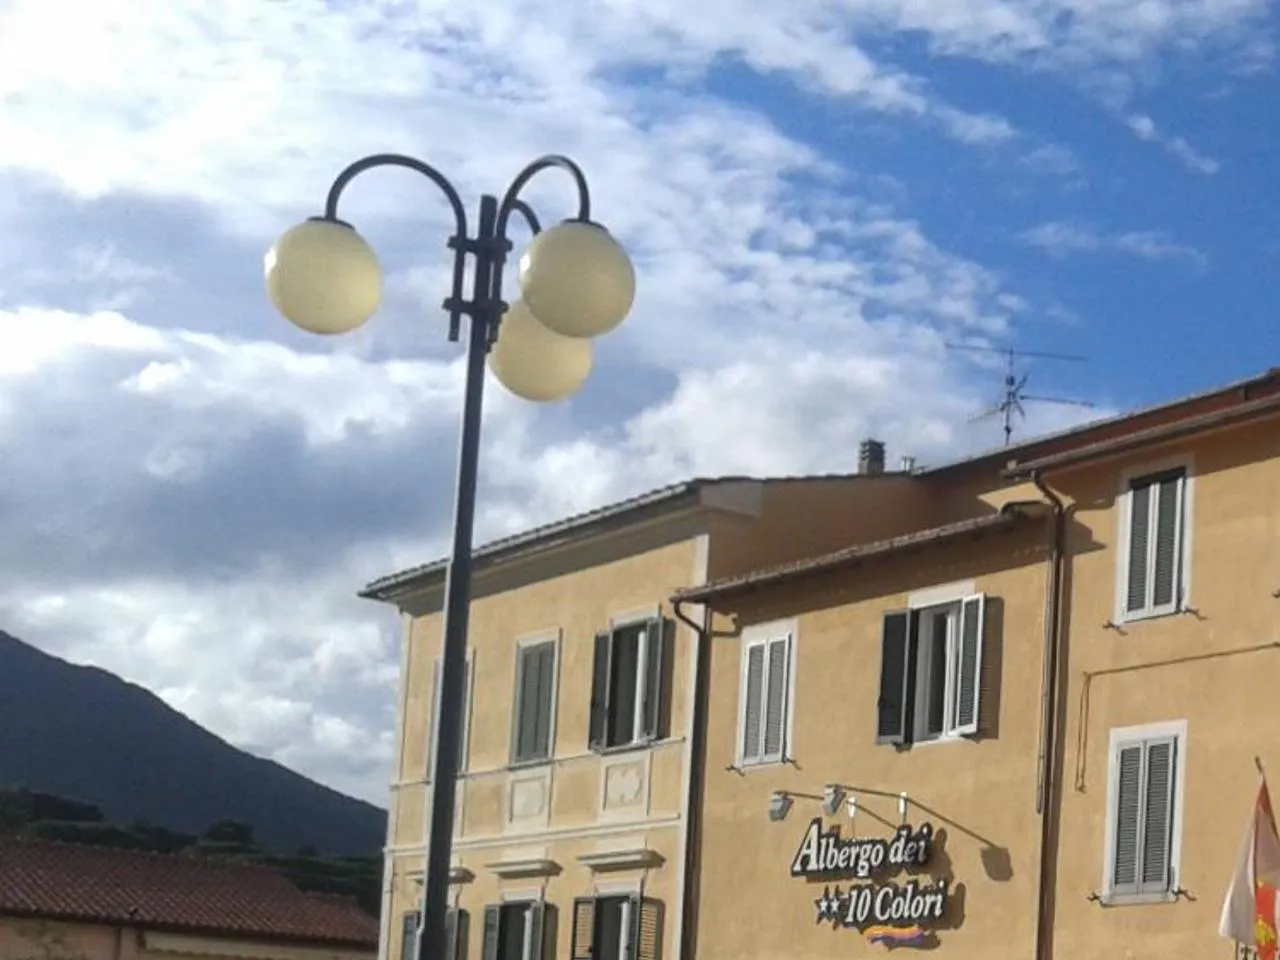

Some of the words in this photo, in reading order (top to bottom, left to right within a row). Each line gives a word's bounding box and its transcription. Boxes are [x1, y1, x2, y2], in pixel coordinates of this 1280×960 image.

[792, 823, 884, 877] Albergo
[889, 825, 928, 865] dei
[845, 887, 872, 923] 10
[874, 879, 945, 922] Colori
